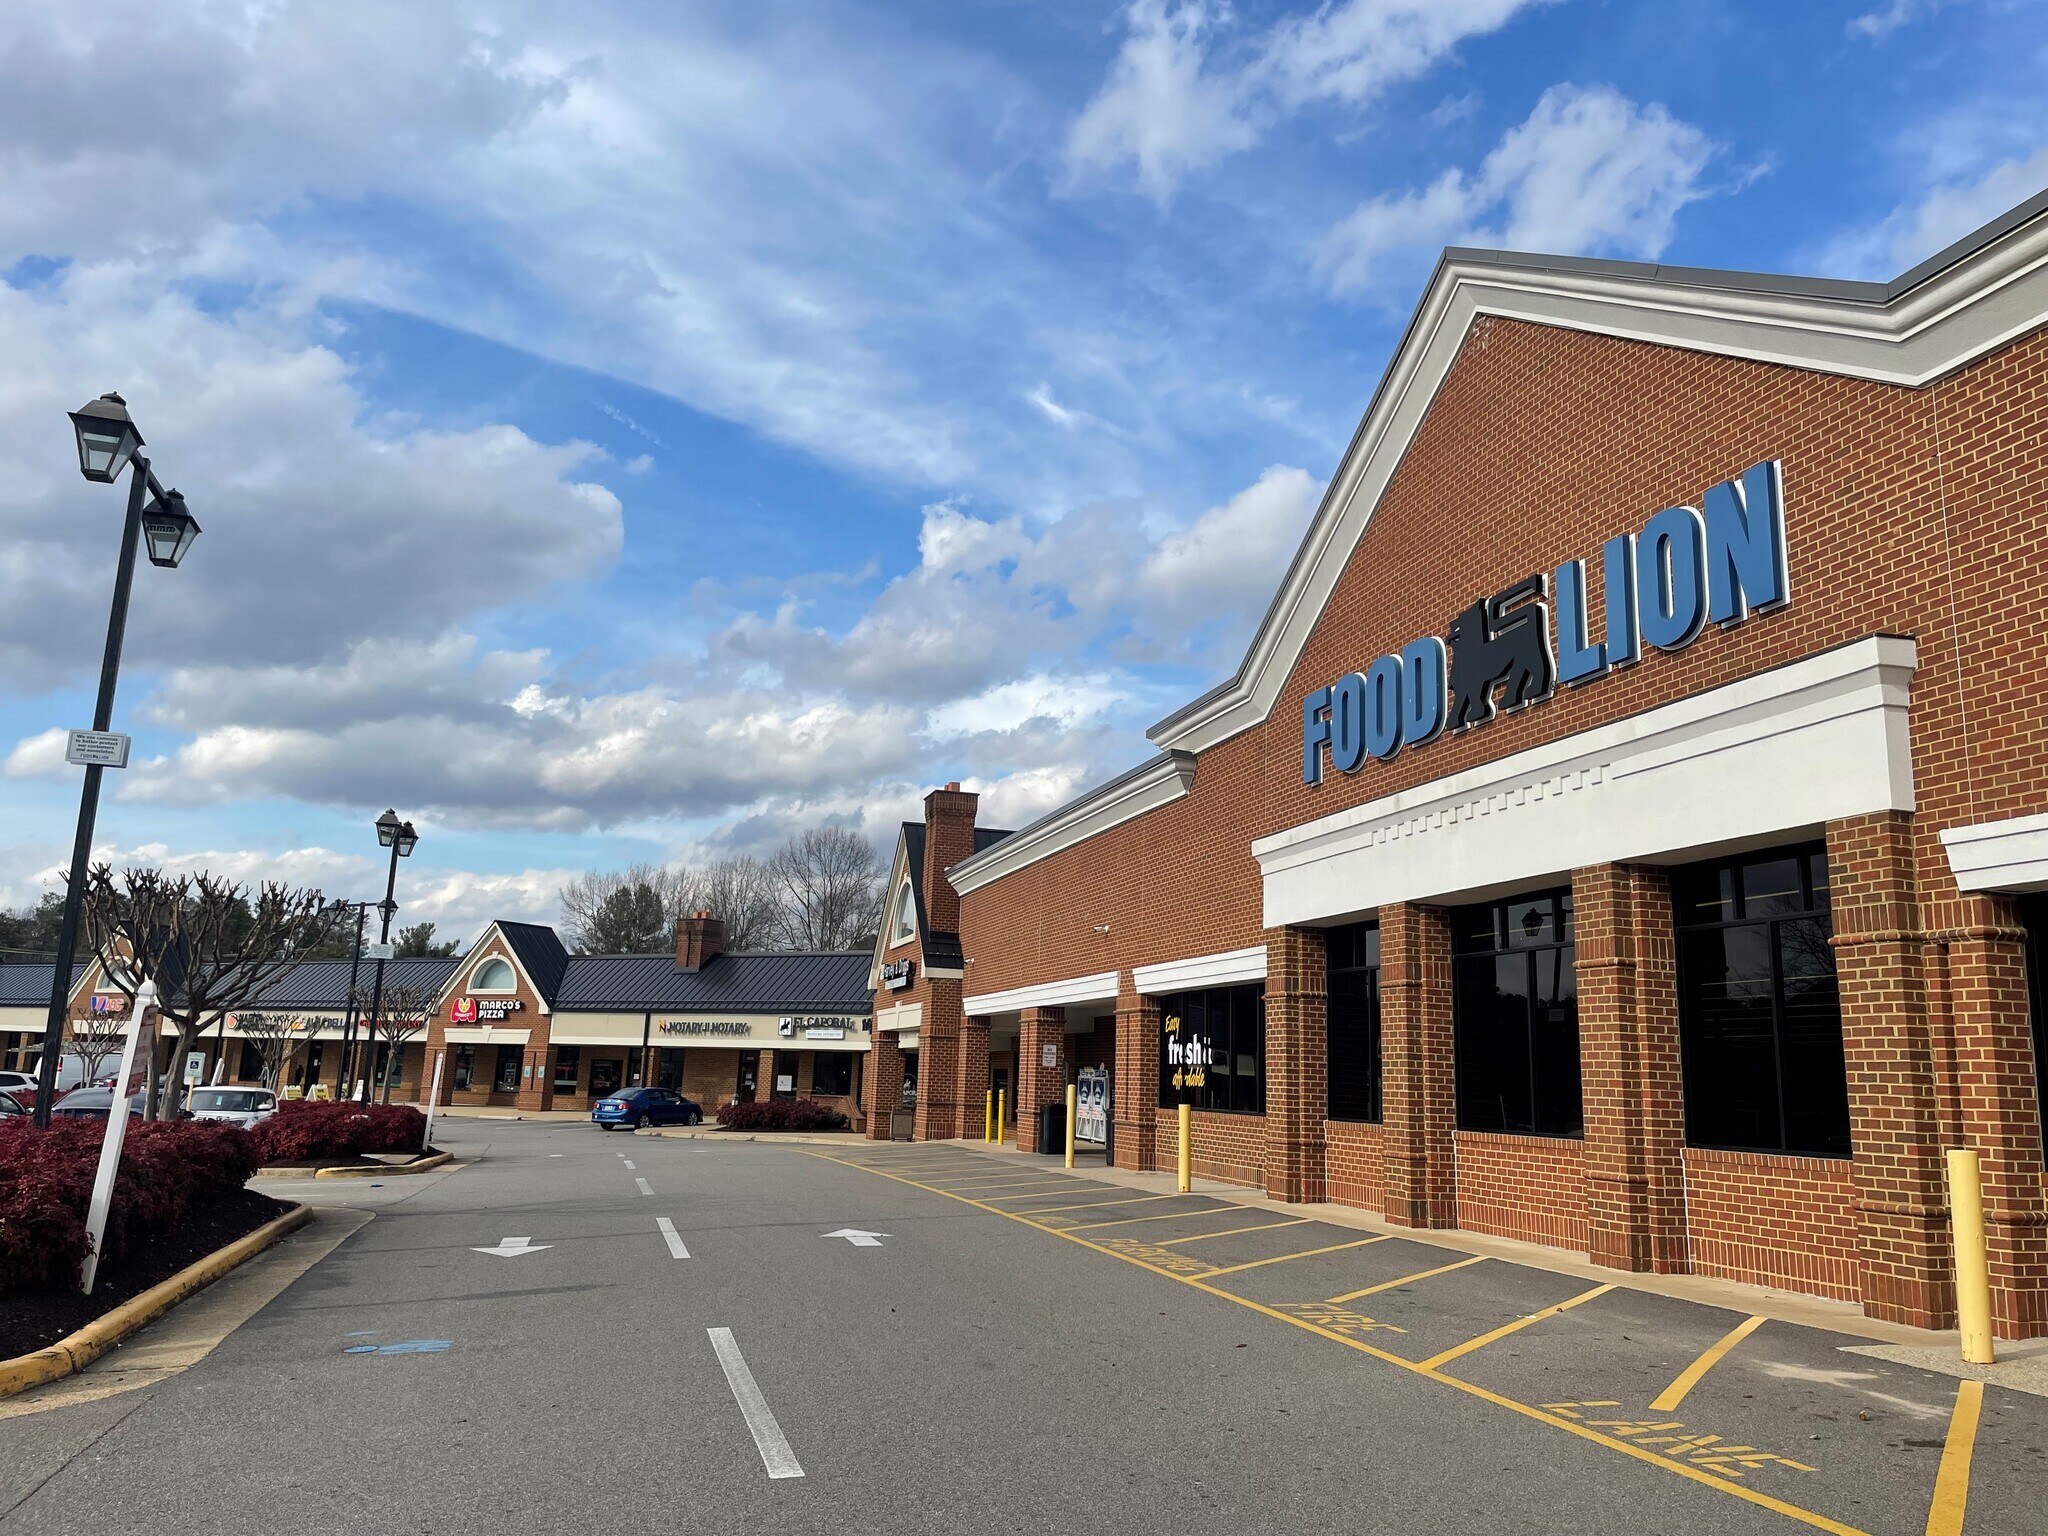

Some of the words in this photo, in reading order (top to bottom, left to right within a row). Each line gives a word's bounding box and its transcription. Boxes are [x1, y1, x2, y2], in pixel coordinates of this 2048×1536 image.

[1303, 636, 1448, 787] FOOD
[1556, 458, 1791, 688] LION
[478, 1010, 505, 1019] PIZZA
[480, 1000, 521, 1010] MARCO'S
[794, 1017, 804, 1028] EL
[807, 1017, 852, 1029] CAPORAL
[1165, 1015, 1180, 1040] Easy
[1172, 1066, 1205, 1090] affrdable
[1269, 1303, 1410, 1335] FIRE
[1538, 1400, 1821, 1477] LANE
